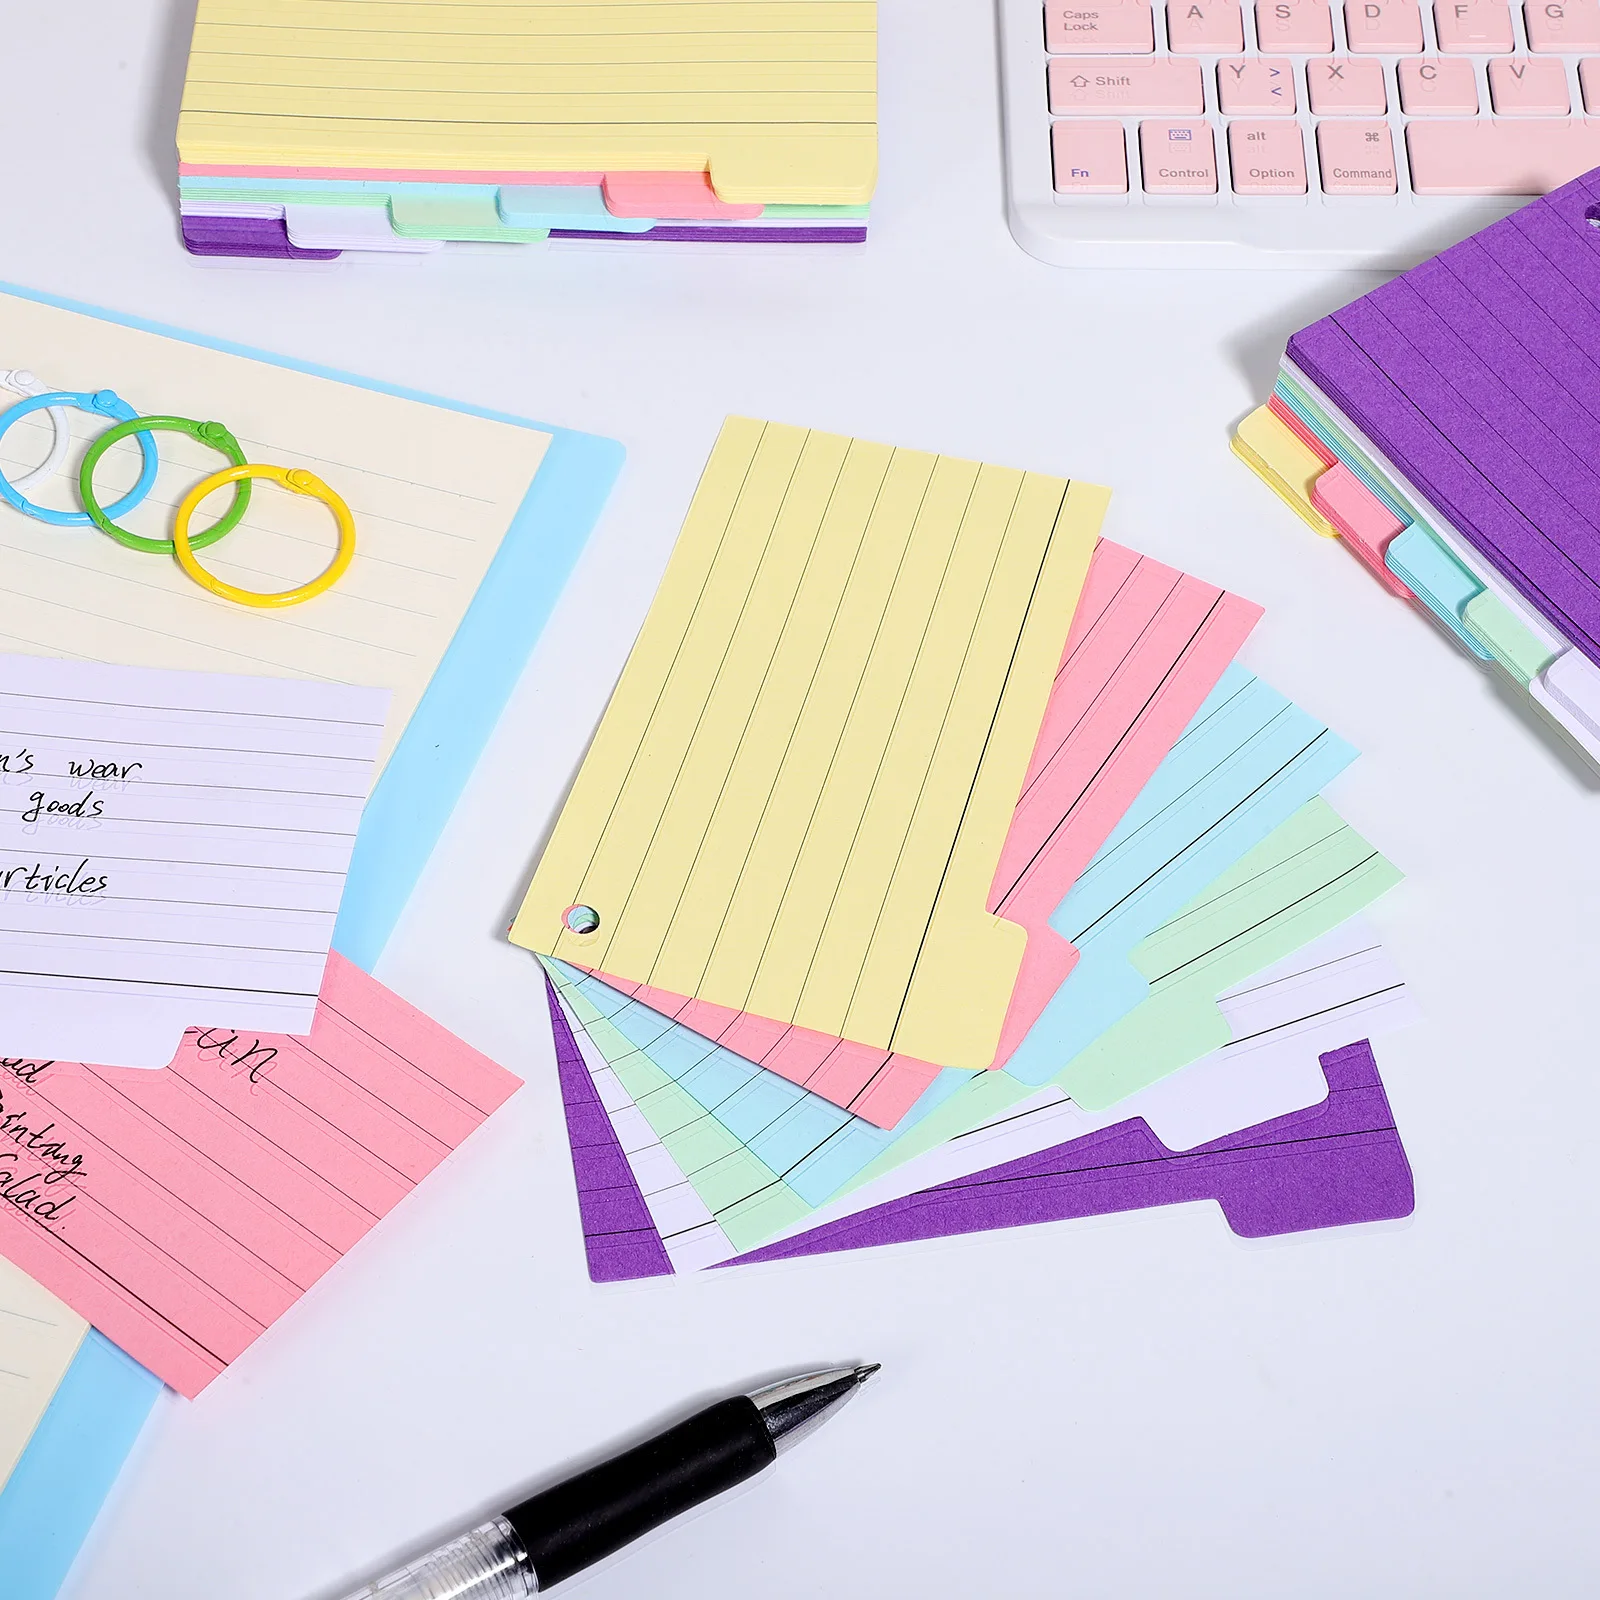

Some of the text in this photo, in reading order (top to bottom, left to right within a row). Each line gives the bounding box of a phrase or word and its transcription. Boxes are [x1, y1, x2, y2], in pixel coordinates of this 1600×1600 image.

[1063, 10, 1099, 20] Caps
[1186, 5, 1204, 19] A
[1275, 5, 1291, 19] S
[1365, 4, 1381, 18] D
[1455, 5, 1468, 18] F
[1545, 4, 1564, 19] G
[1063, 22, 1099, 31] Lock
[1229, 65, 1246, 79] Y
[1327, 65, 1344, 79] X
[1419, 65, 1437, 79] C
[1509, 65, 1525, 79] V
[1095, 76, 1131, 87] Shift
[1247, 131, 1266, 141] alt
[1071, 168, 1089, 178] Fn
[1159, 168, 1209, 178] Control
[1249, 168, 1295, 180] Option
[1333, 168, 1392, 179] Command
[68, 759, 143, 779] wear
[22, 790, 104, 822] goods
[0, 858, 108, 893] rticles
